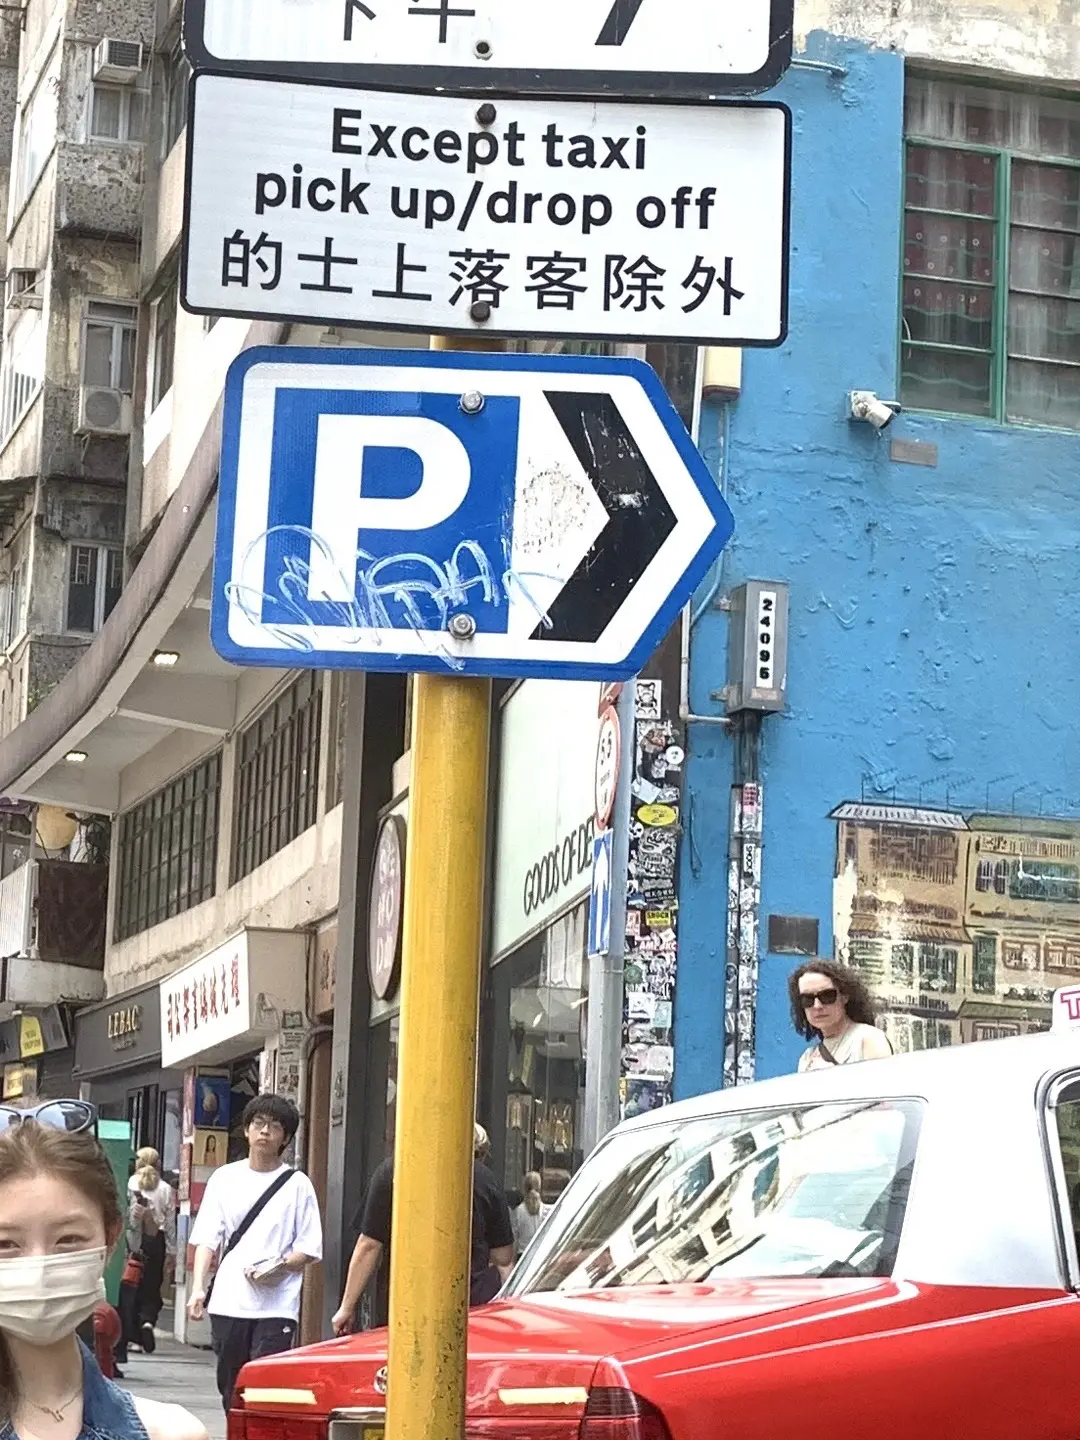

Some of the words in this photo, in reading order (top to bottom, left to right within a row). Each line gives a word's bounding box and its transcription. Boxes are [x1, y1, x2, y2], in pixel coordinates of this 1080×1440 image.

[332, 108, 525, 173] Except
[542, 122, 647, 169] taxi
[255, 164, 369, 215] pick
[391, 180, 613, 234] up/drop
[635, 186, 718, 230] off
[221, 230, 745, 316] 的士上落客除外
[308, 413, 471, 603] P
[759, 598, 773, 680] 24095
[523, 845, 560, 917] GOODS
[561, 829, 577, 886] OF
